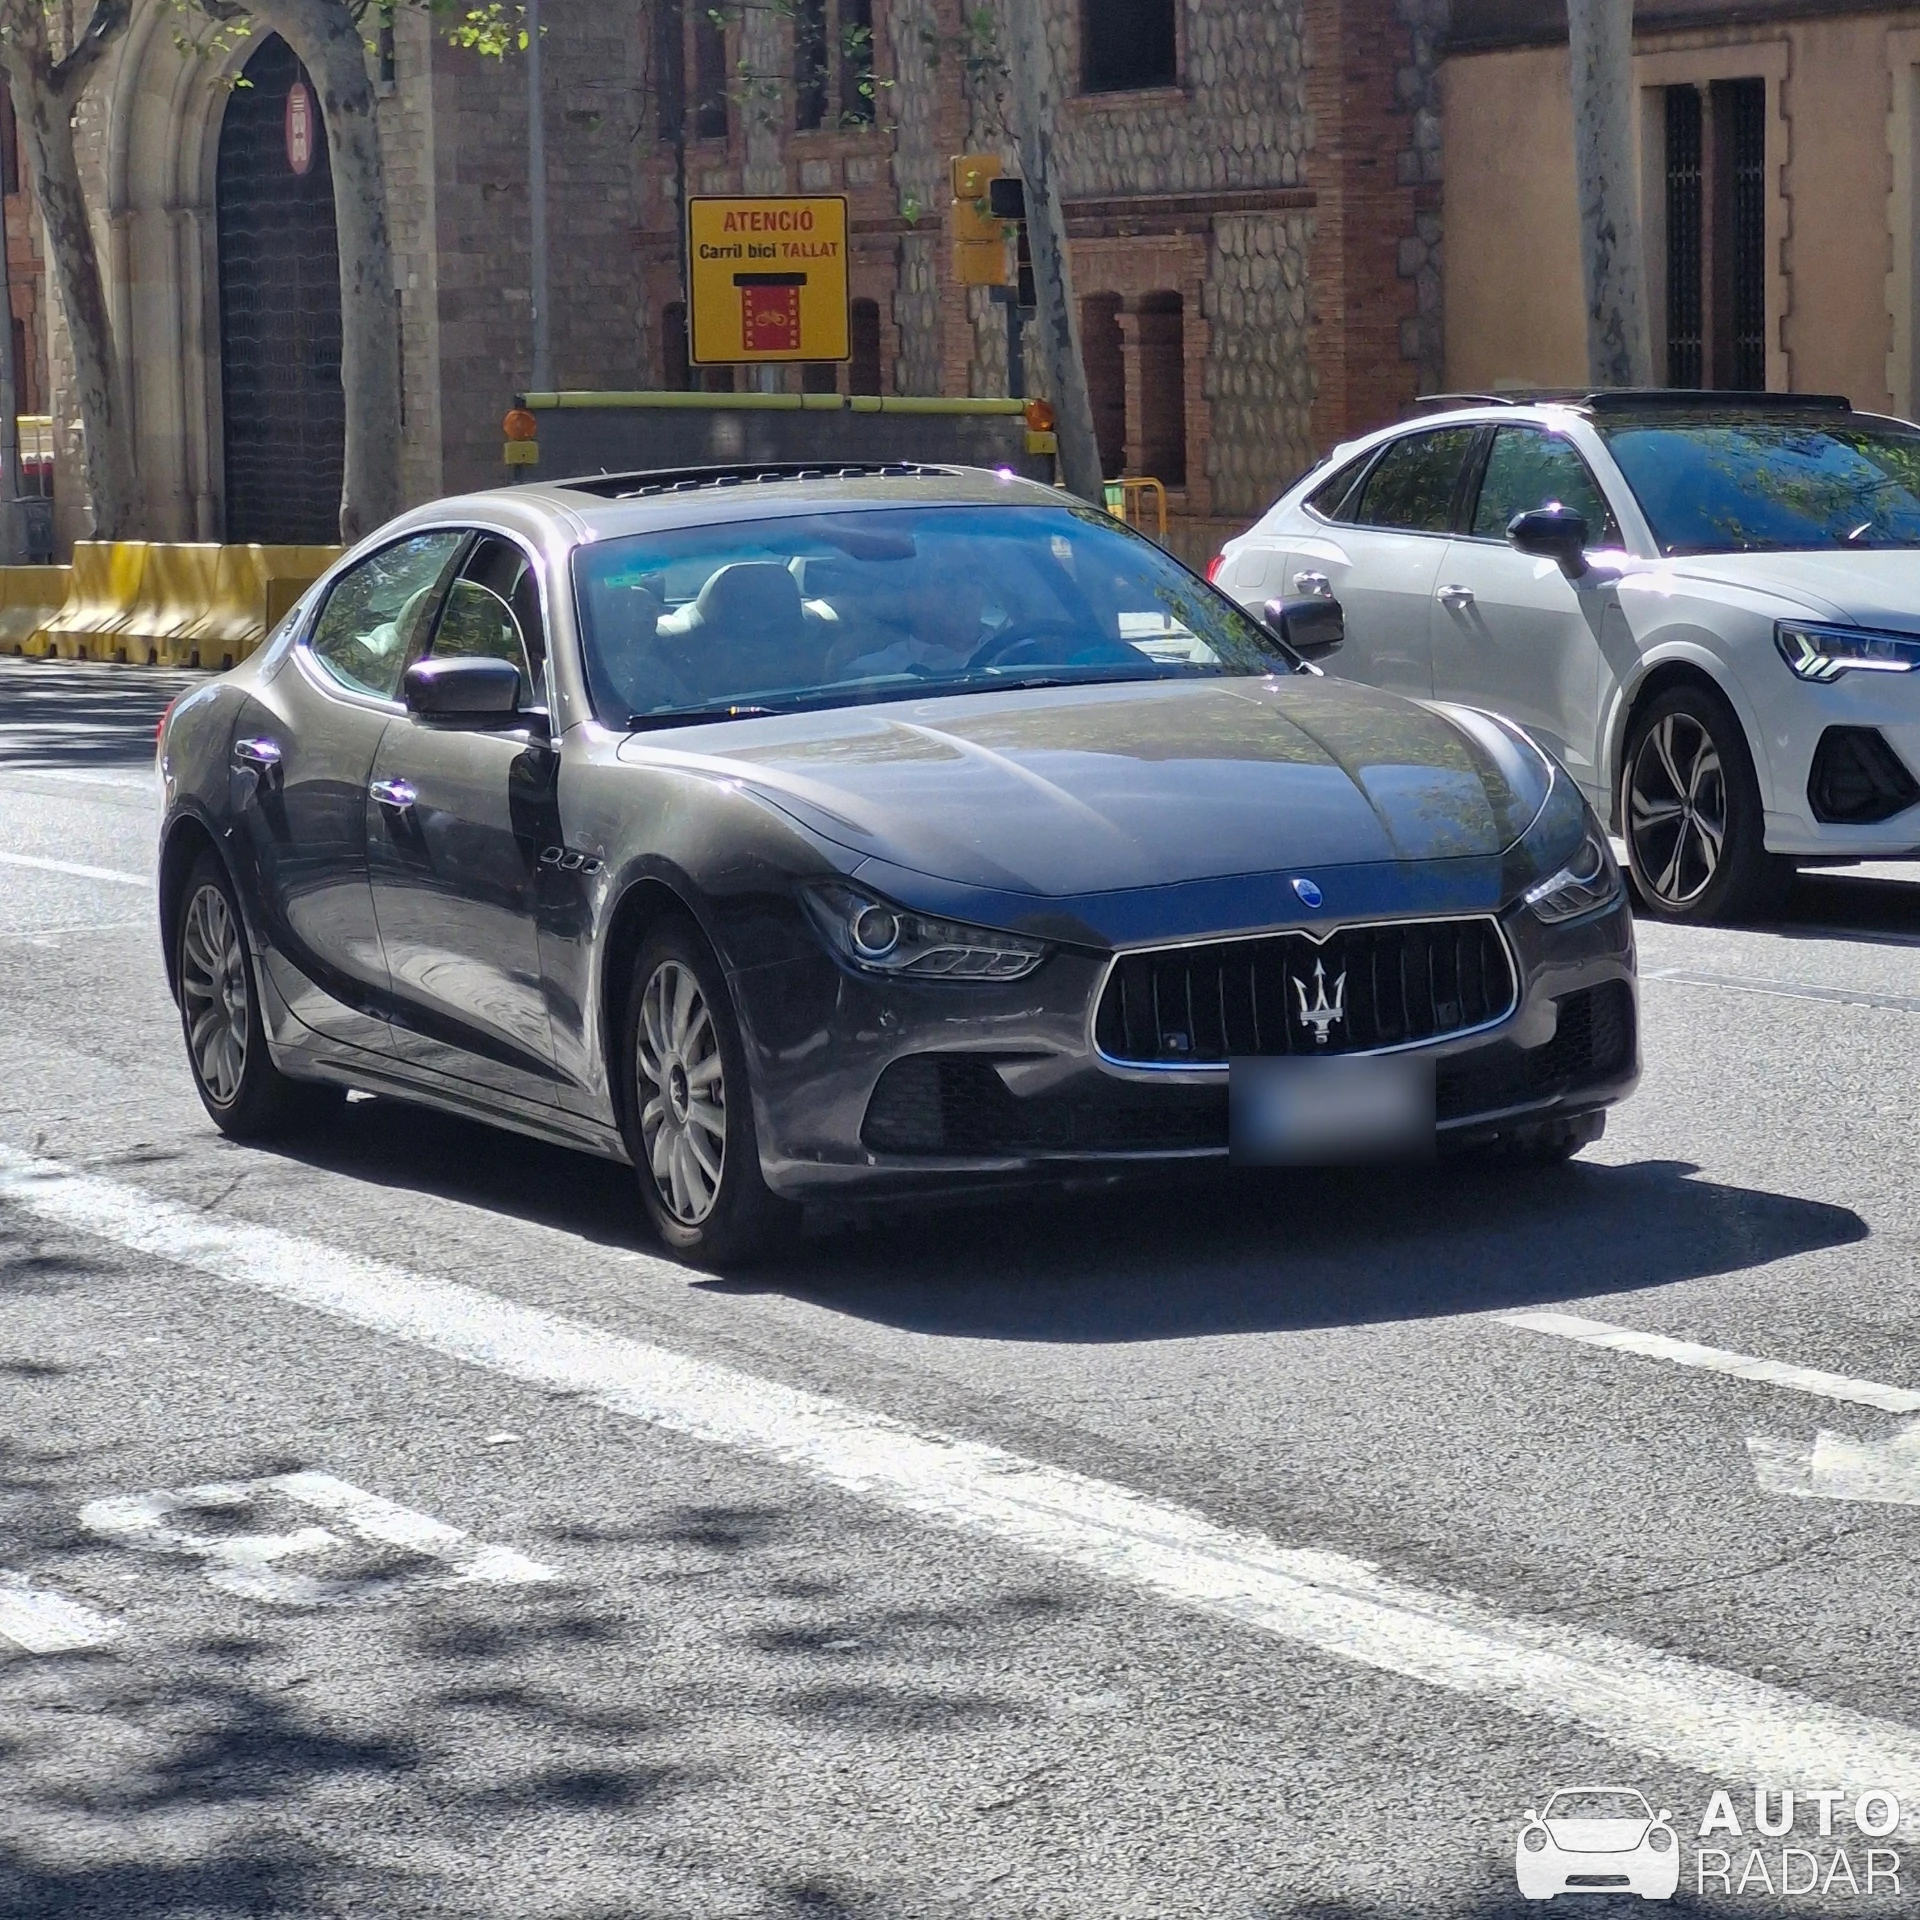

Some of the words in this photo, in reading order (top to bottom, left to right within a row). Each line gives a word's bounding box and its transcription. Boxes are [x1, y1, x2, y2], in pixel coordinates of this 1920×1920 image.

[724, 206, 814, 232] ATENCIÓ
[700, 243, 742, 259] Carril
[748, 243, 776, 259] bici
[781, 242, 838, 258] TALLAT
